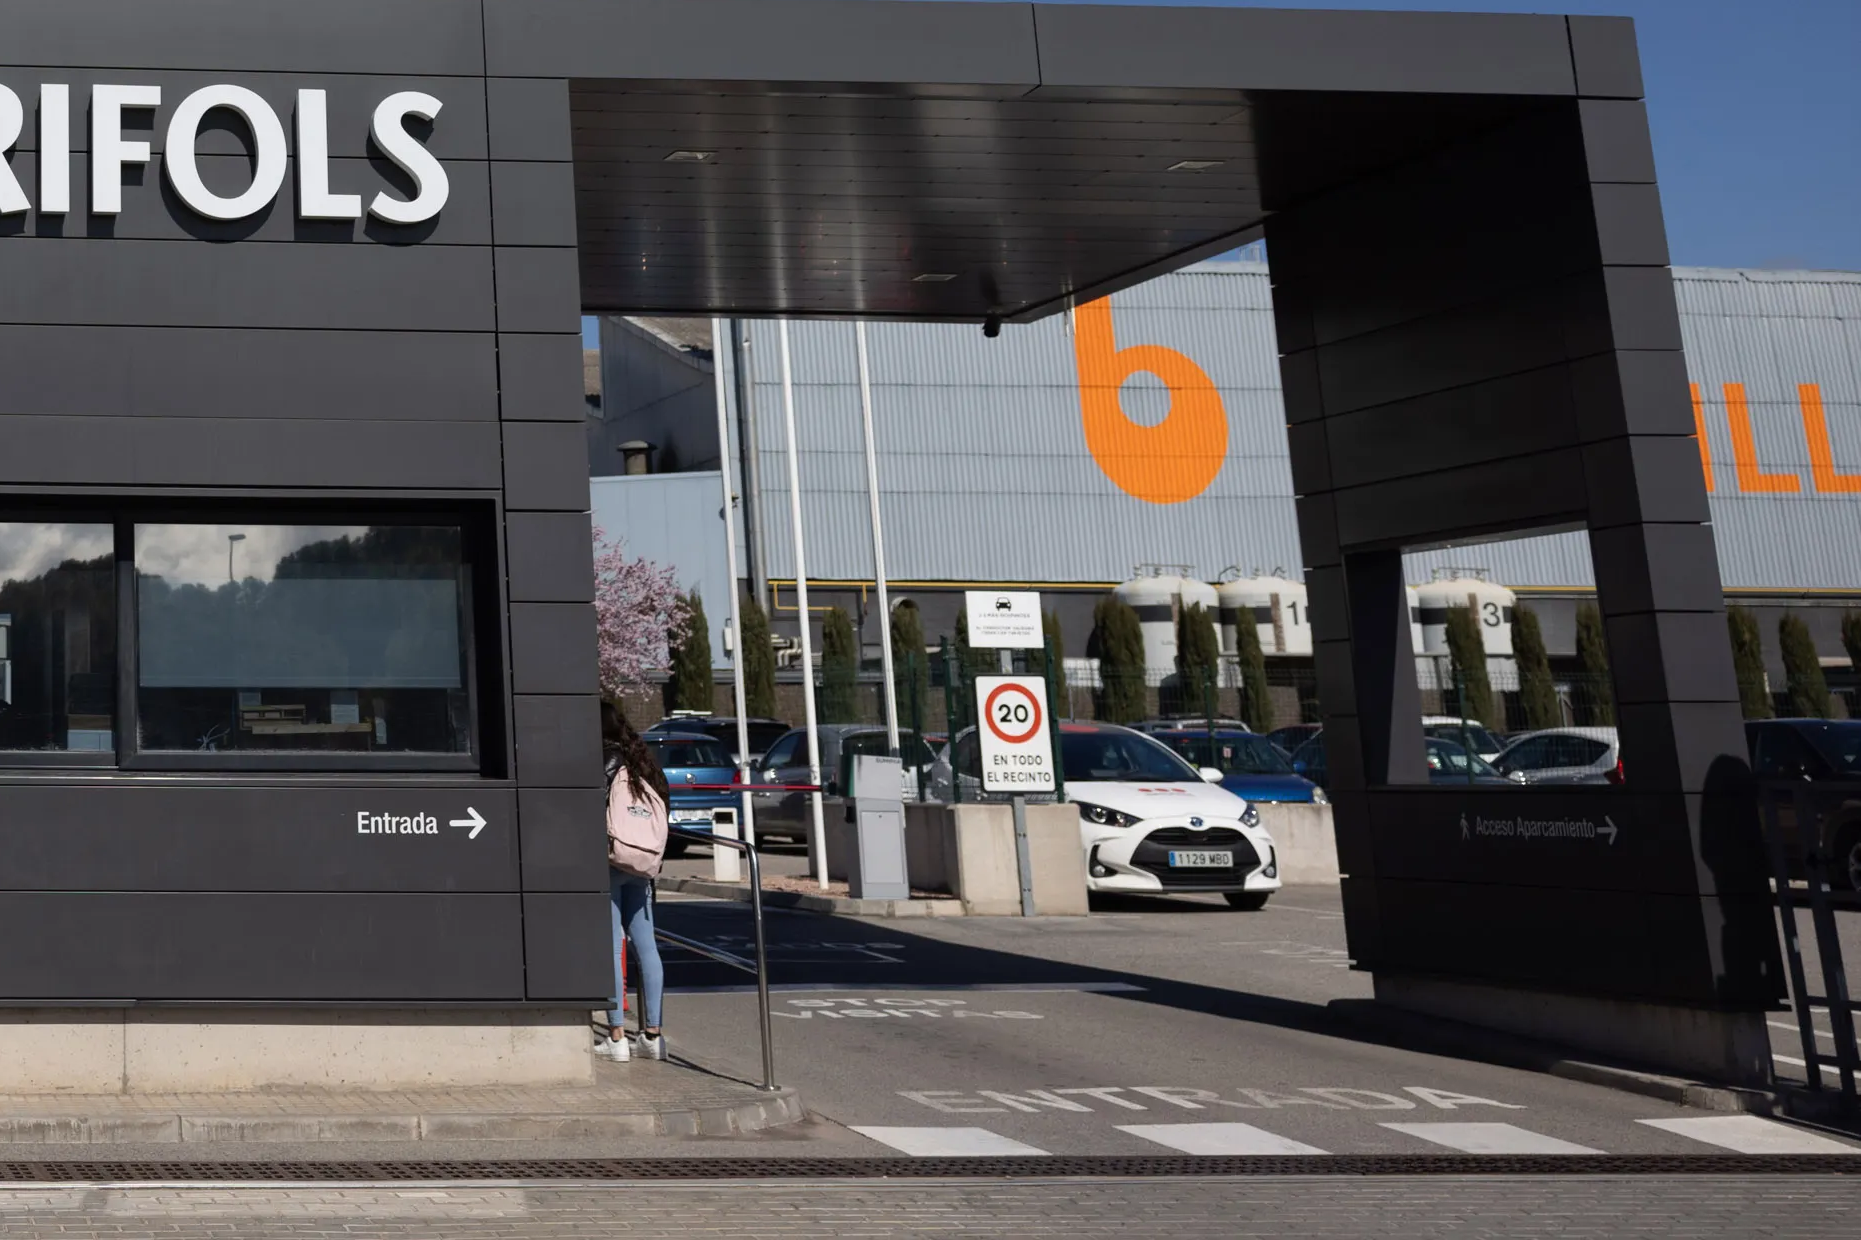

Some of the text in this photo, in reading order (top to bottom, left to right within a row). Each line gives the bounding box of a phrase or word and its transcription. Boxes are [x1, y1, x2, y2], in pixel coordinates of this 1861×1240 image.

[1286, 601, 1299, 626] 1
[1483, 602, 1502, 627] 3
[998, 703, 1029, 724] 20
[993, 754, 1043, 766] EN TODO
[987, 771, 1052, 783] EL RECINTO
[357, 811, 439, 834] Entrada
[1475, 816, 1596, 841] Acceso Aparcamiento
[1178, 853, 1206, 865] 1129
[786, 997, 968, 1008] STOP
[770, 1008, 1045, 1020] VISITAS
[895, 1085, 1529, 1113] ENTRADA
